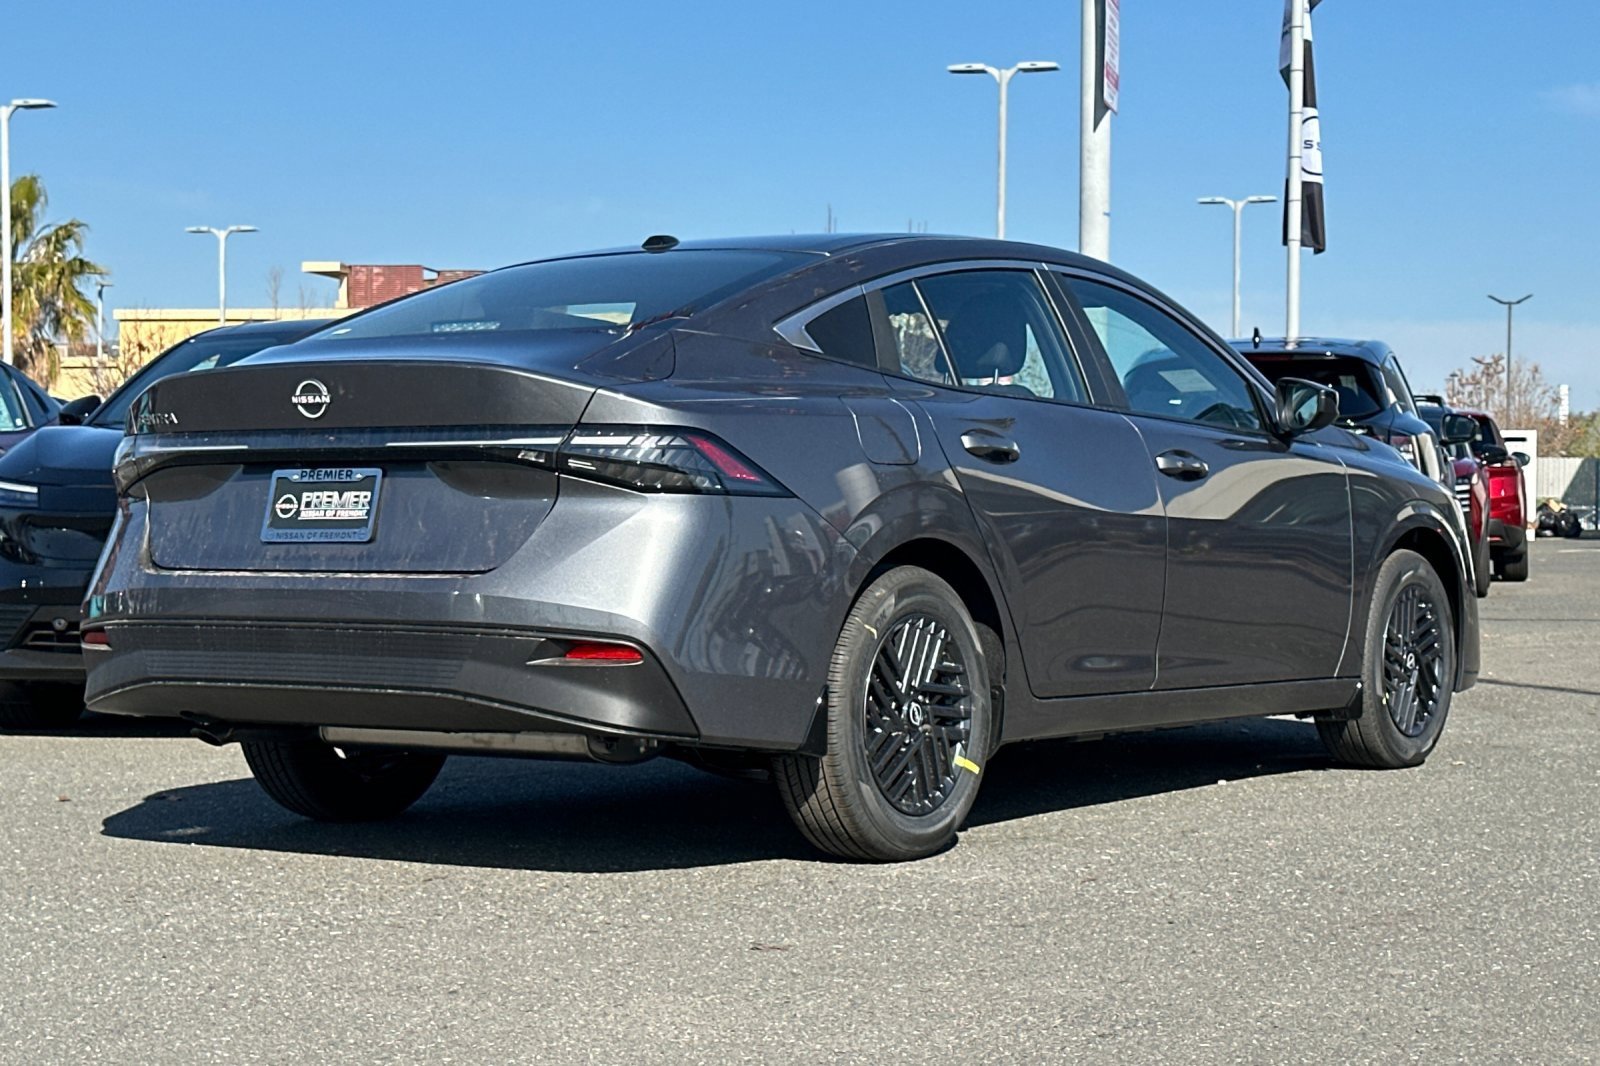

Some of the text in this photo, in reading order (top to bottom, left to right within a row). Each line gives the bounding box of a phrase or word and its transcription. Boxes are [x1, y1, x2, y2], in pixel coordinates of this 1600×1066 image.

[291, 395, 331, 404] NISSAN
[300, 469, 353, 480] PREMIER
[301, 490, 372, 509] PREMIER
[275, 530, 358, 540] NISSAN OF FREMONT
